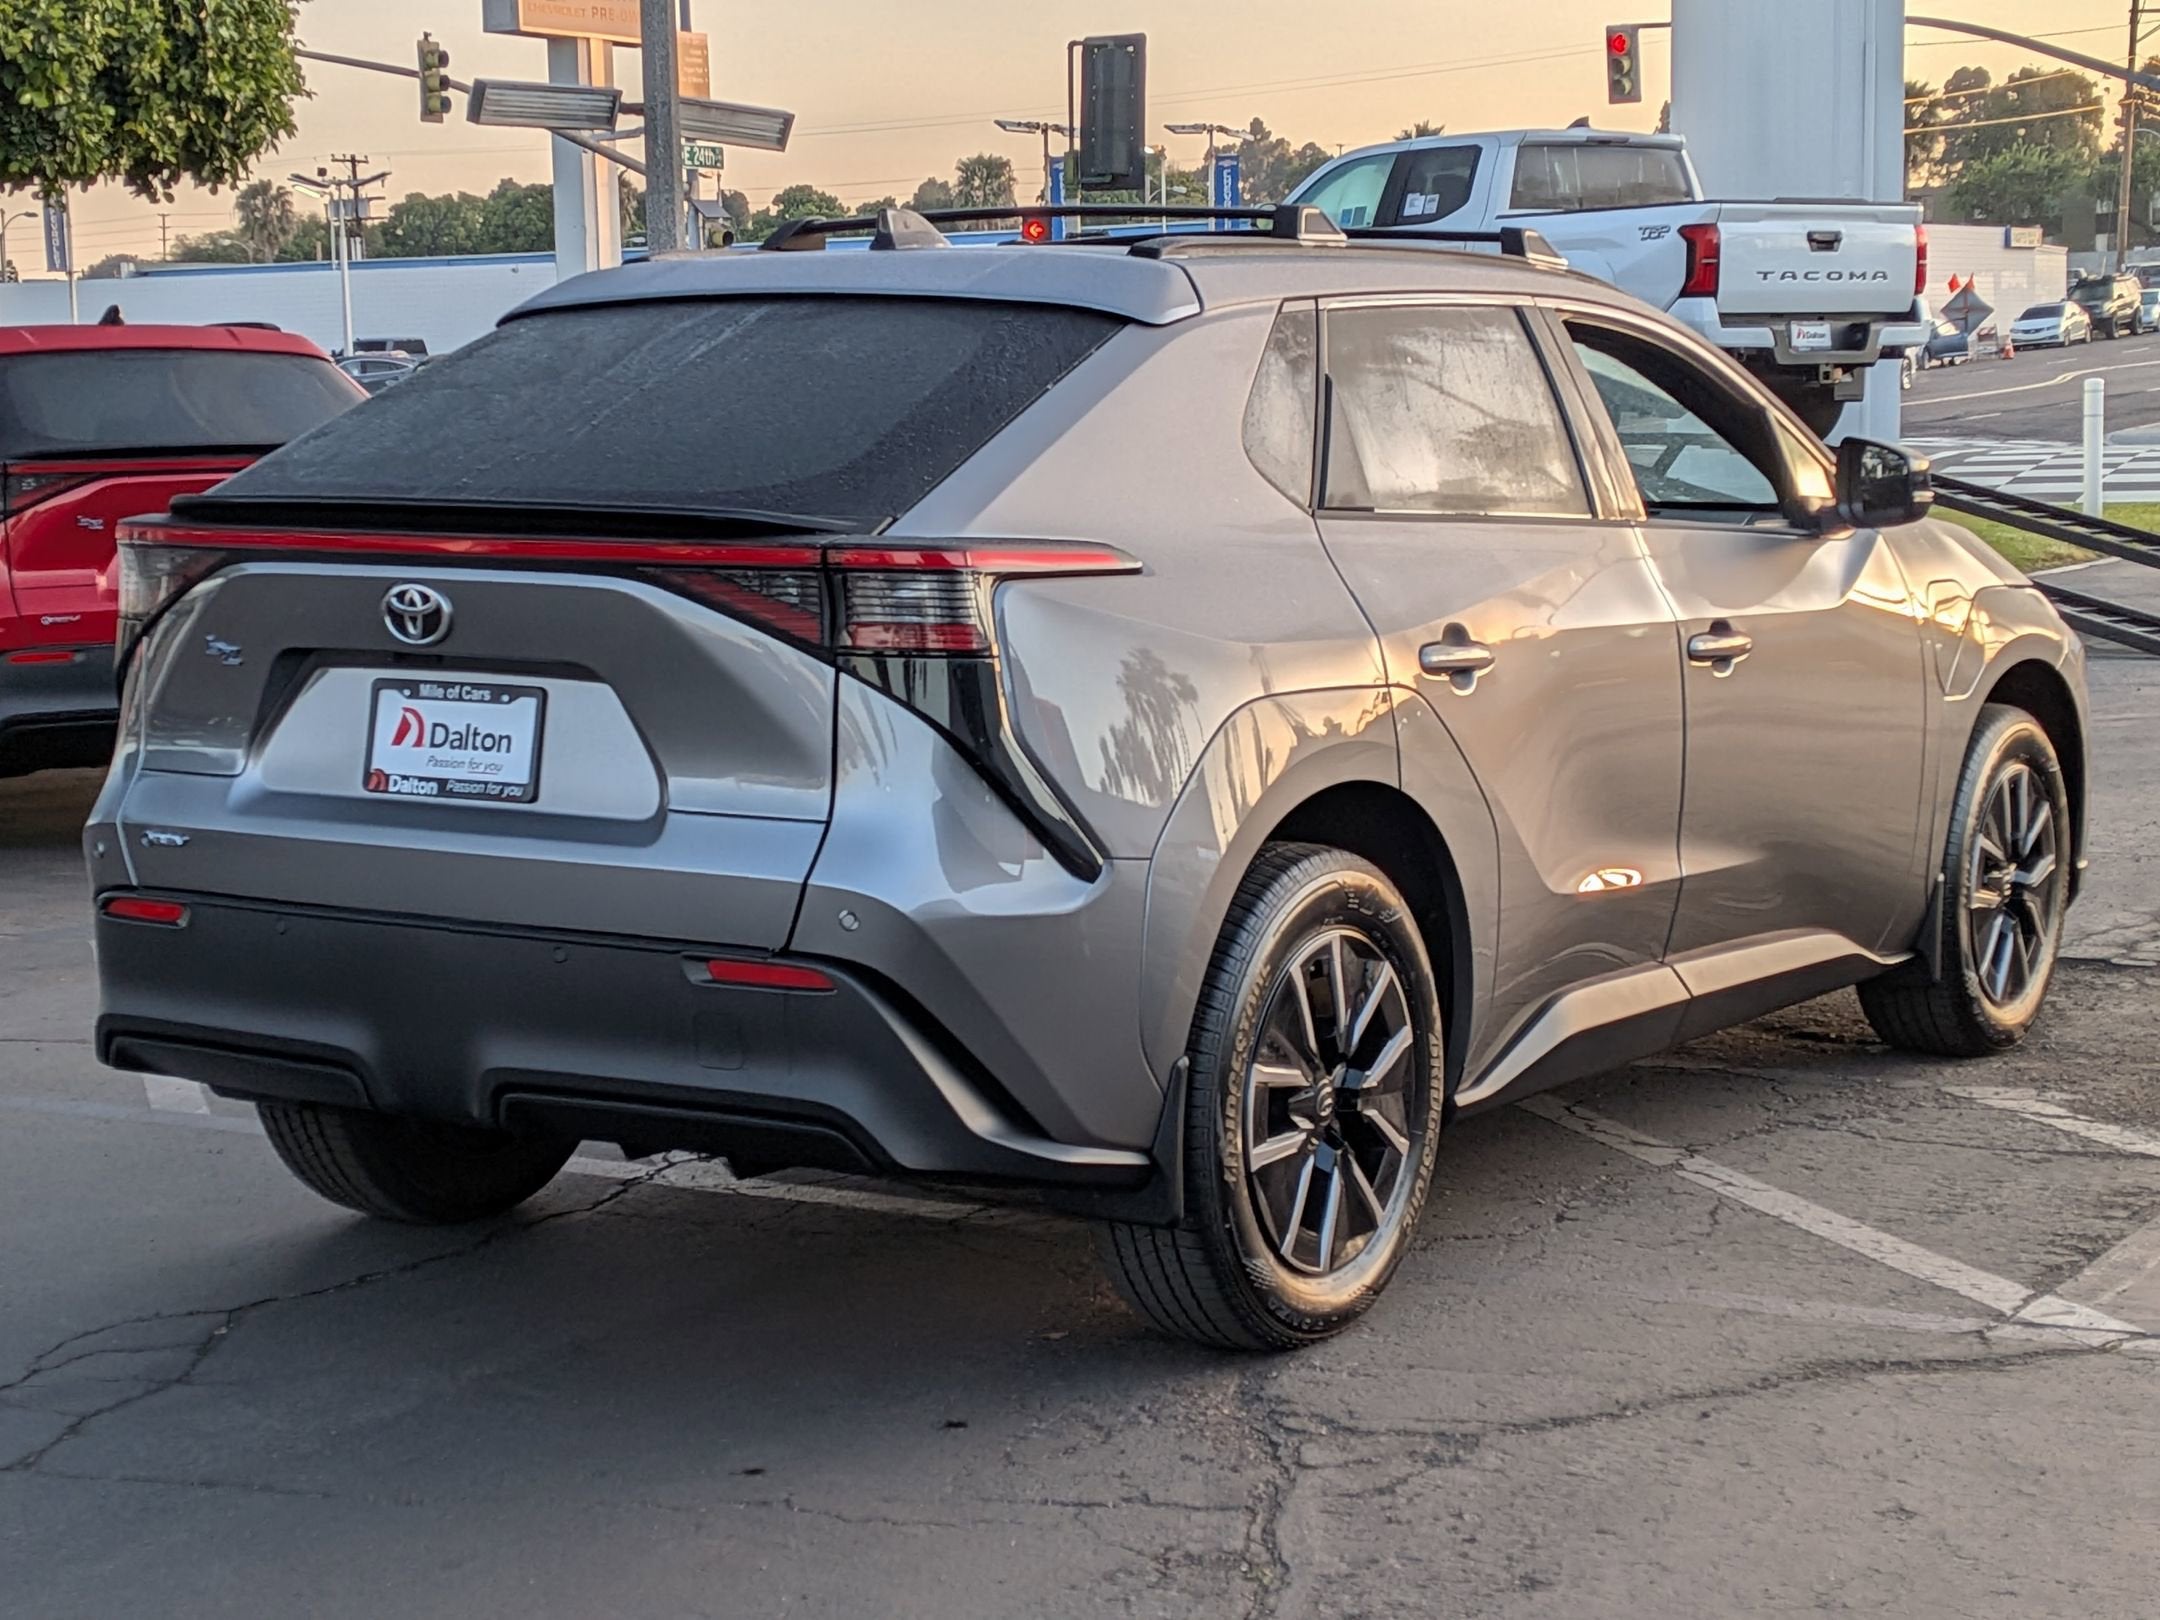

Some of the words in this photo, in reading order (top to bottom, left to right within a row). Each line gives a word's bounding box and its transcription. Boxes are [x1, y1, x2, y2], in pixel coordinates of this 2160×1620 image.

[527, 2, 586, 18] CHEVROLET
[591, 6, 639, 23] PRE-OW
[684, 146, 693, 166] E
[693, 146, 715, 167] 24th
[1756, 270, 1889, 281] TACOMA
[419, 683, 445, 699] Mile
[446, 685, 461, 699] of
[461, 686, 491, 701] Cars
[429, 722, 512, 754] Dalton
[426, 755, 466, 769] Passion
[467, 757, 481, 771] for
[481, 761, 503, 773] you
[388, 774, 438, 796] Dalton
[446, 780, 485, 793] Passion
[486, 782, 502, 795] for
[503, 785, 525, 799] you
[1224, 964, 1271, 1185] BRIDGESTONE
